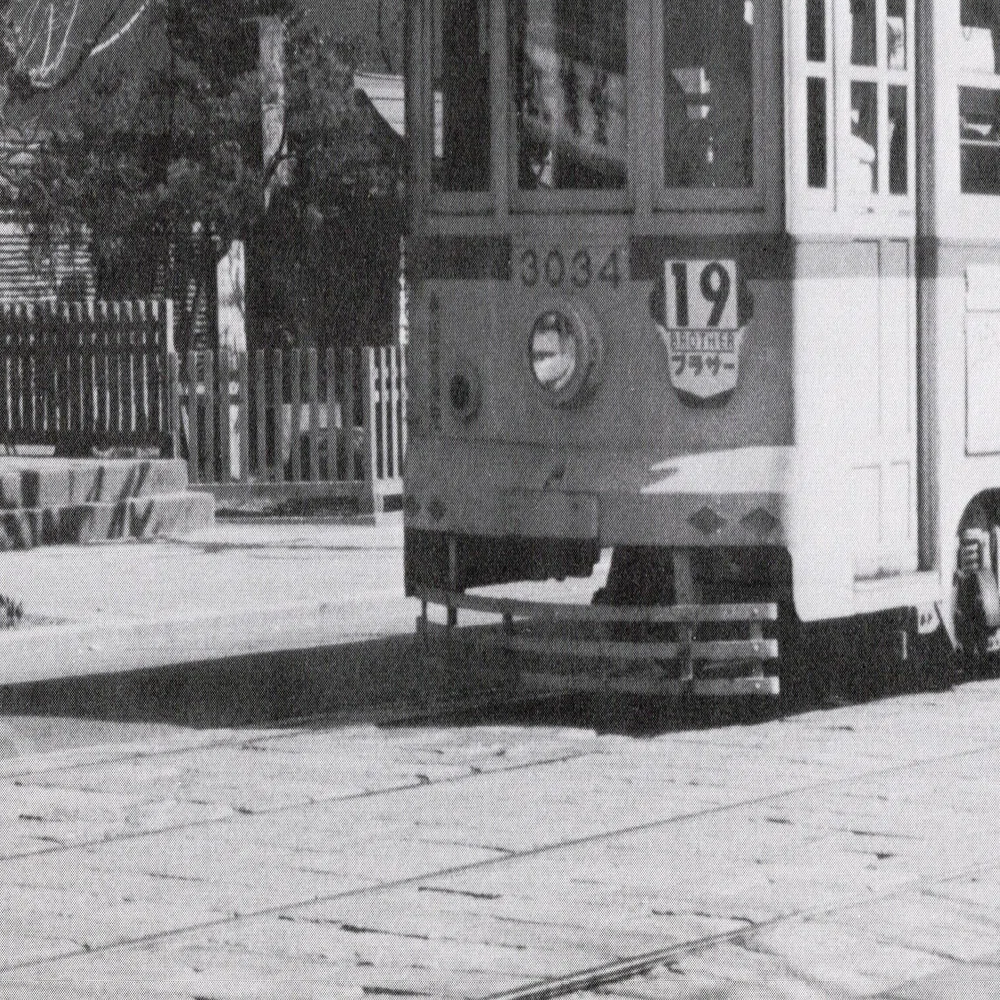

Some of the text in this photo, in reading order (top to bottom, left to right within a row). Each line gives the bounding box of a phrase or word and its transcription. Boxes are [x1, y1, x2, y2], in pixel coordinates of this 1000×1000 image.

[520, 250, 620, 289] 3034
[671, 261, 731, 328] 19
[671, 353, 735, 377] ブラザー
